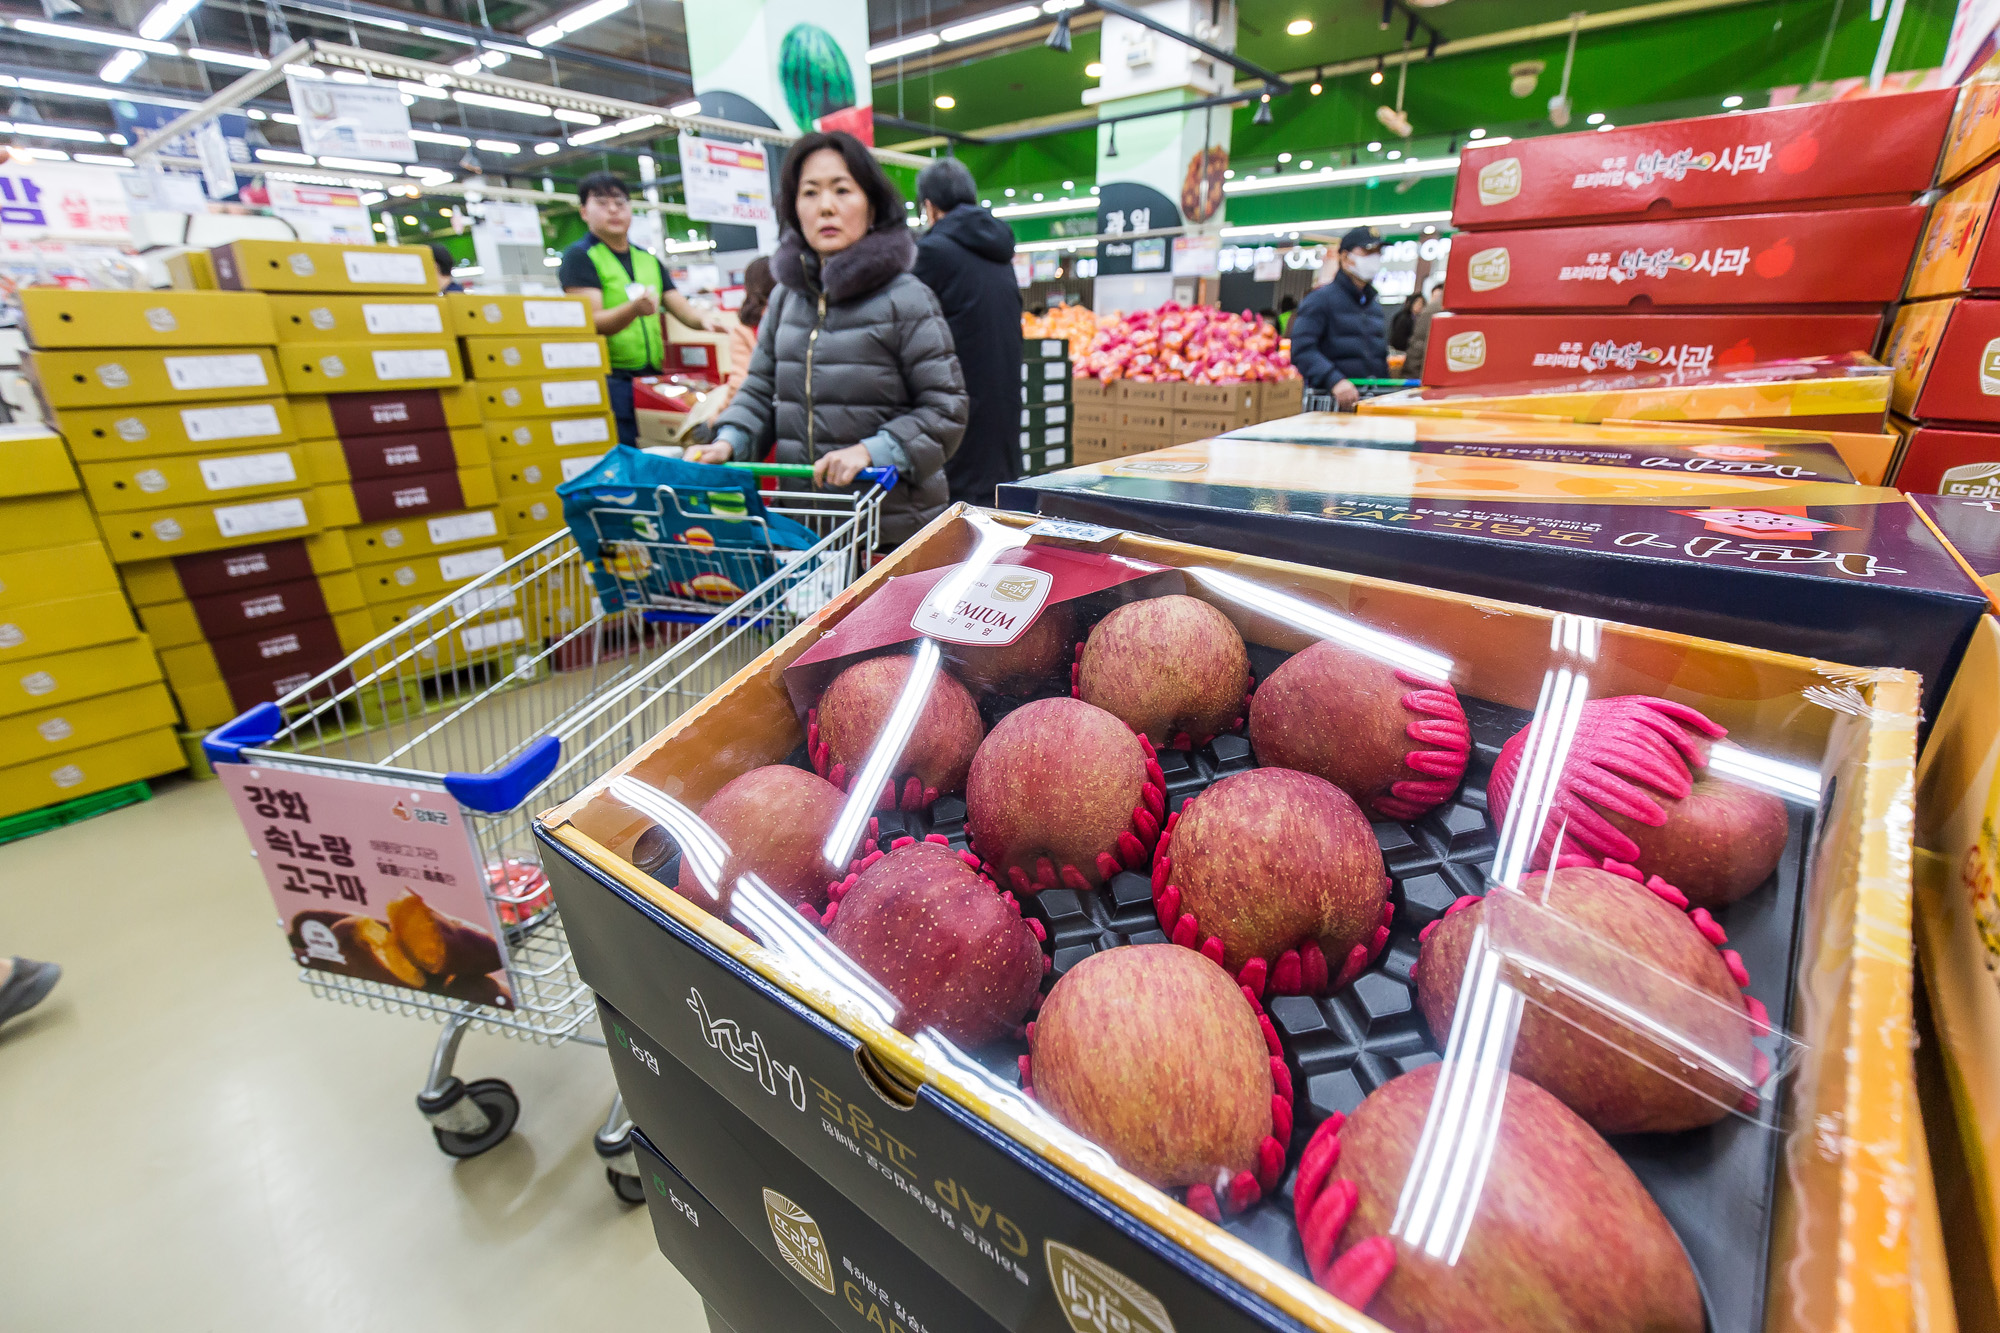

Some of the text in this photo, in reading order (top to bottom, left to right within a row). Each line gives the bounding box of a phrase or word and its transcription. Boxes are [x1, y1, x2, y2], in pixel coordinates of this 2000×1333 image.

[1713, 142, 1773, 176] 사과
[1104, 207, 1150, 237] 과일
[1558, 266, 1609, 281] 프리미엄
[1692, 246, 1751, 277] 사과
[1661, 344, 1714, 371] 사과
[1322, 506, 1424, 522] GAP
[1433, 518, 1594, 544] 고당도
[243, 785, 312, 825] 강화
[263, 825, 356, 869] 속노랑
[276, 861, 368, 906] 고구마
[629, 1037, 660, 1077] 농협
[821, 1117, 862, 1157] 재배한
[809, 1076, 1029, 1258] GAP 고당도
[669, 1188, 700, 1228] 농협
[774, 1212, 825, 1273] 뜨라네
[842, 1256, 890, 1307] 특허받은
